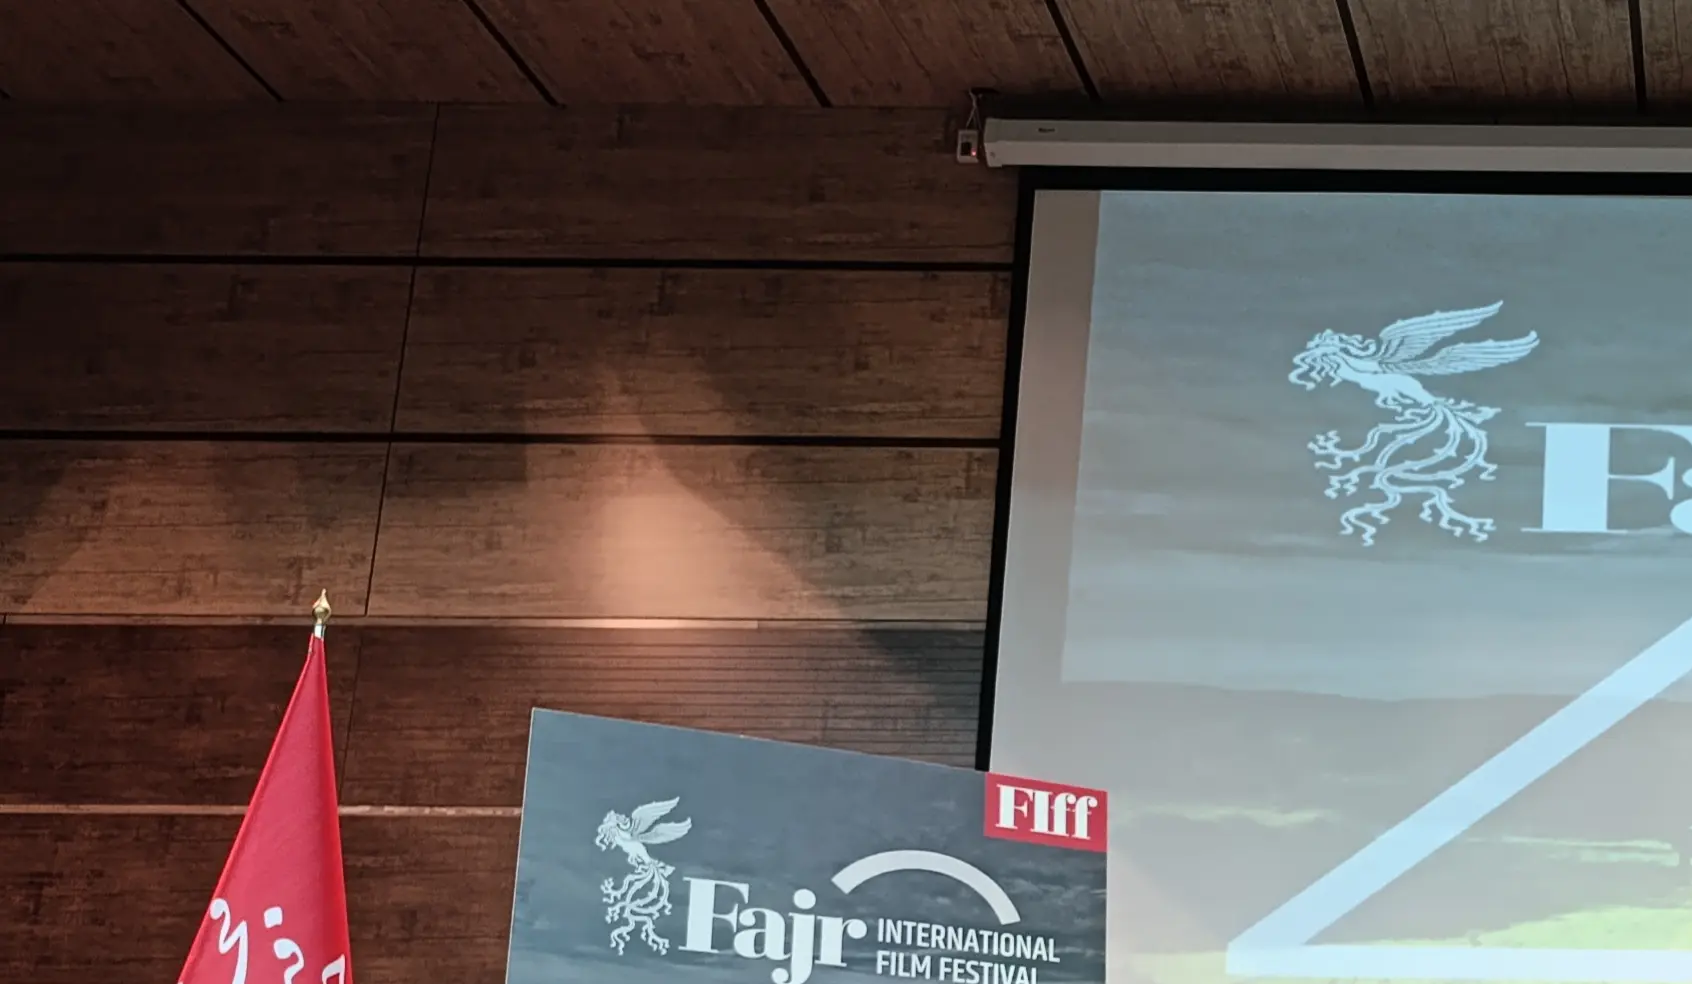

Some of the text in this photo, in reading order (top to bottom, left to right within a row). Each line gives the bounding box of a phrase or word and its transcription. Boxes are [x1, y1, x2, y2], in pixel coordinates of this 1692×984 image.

[995, 783, 1098, 841] FIff
[876, 918, 1061, 963] INTERNATIONAL
[875, 956, 932, 980] FILM
